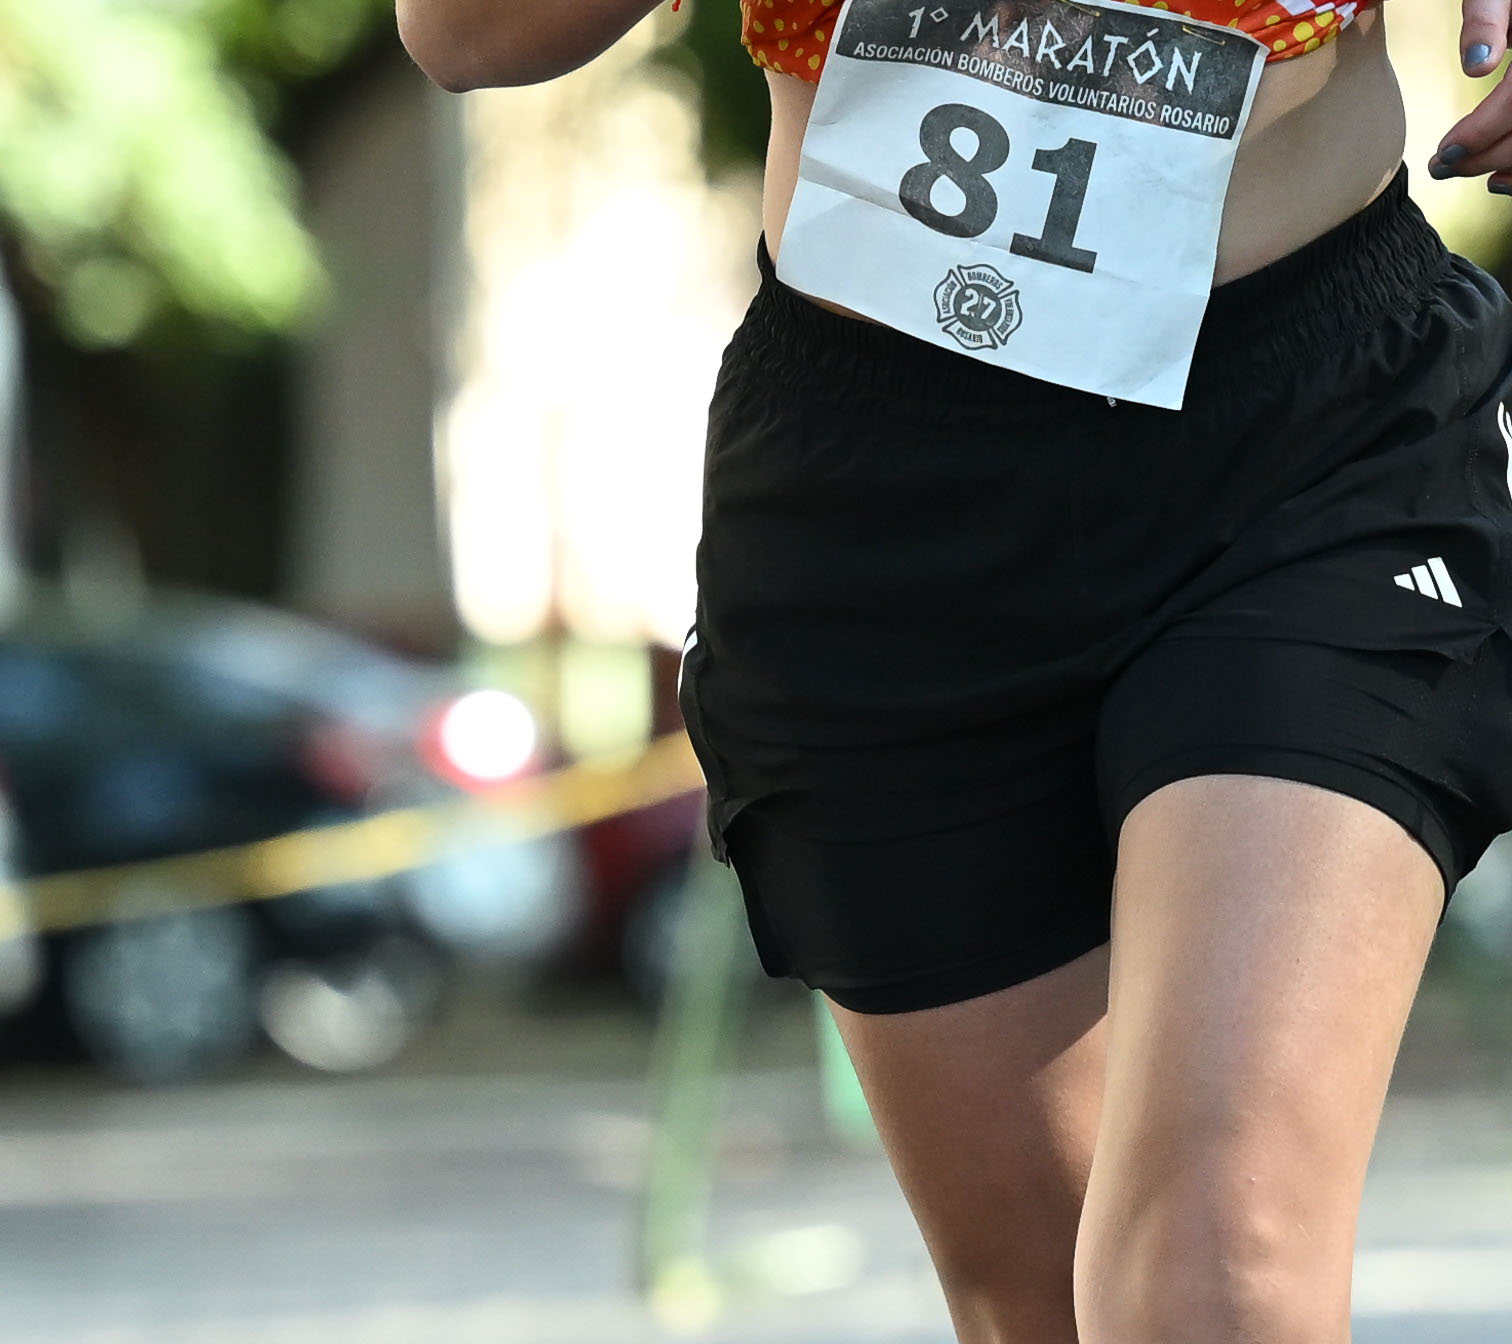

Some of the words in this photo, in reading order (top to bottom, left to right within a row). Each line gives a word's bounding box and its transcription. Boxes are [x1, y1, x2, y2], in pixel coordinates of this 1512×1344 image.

[853, 41, 955, 67] ASOCIACIÓN
[957, 53, 1044, 97] BOMBEROS
[1048, 81, 1157, 120] VOLUNTARIOS
[1159, 104, 1230, 135] ROSARIO
[959, 10, 1203, 96] MARATÓN
[898, 102, 1098, 274] 81
[960, 288, 997, 320] 27
